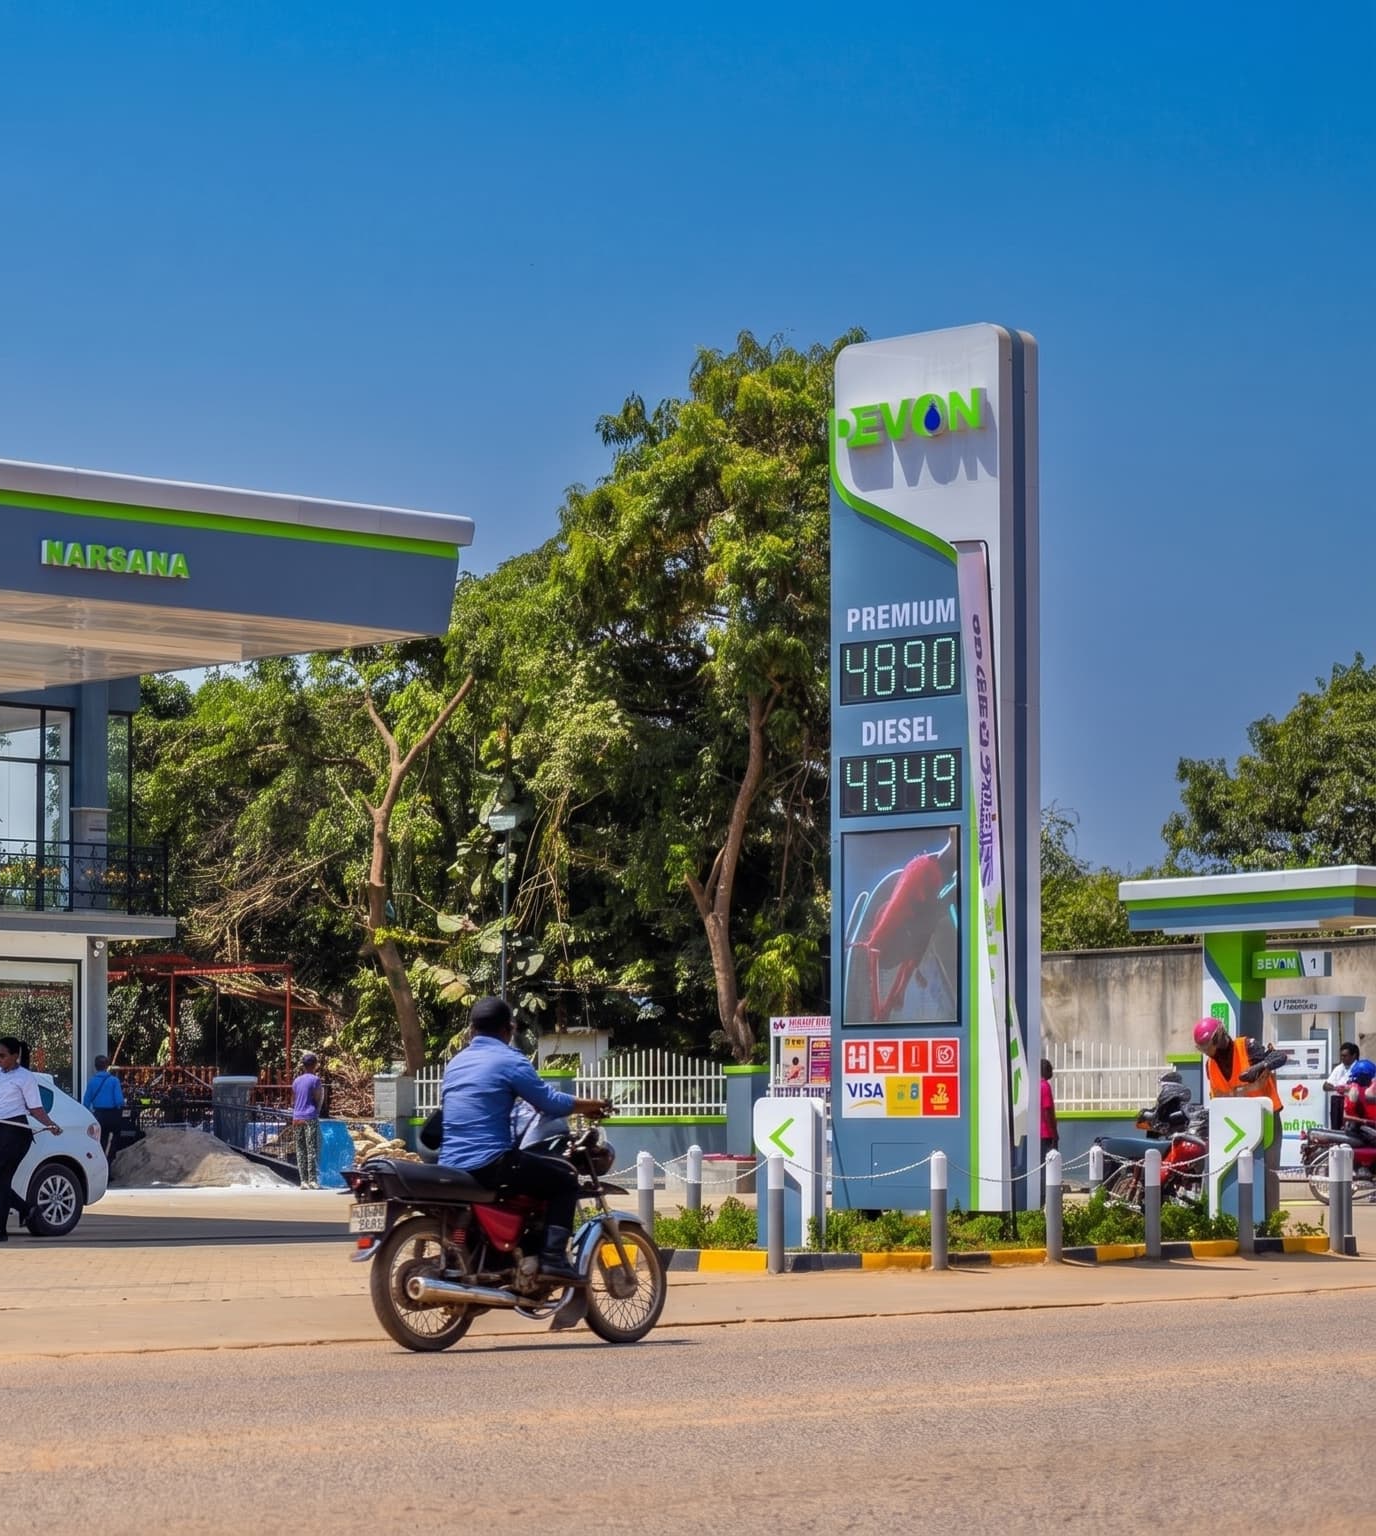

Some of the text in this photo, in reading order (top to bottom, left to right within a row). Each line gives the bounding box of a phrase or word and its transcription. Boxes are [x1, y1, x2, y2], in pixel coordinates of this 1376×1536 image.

[837, 387, 985, 448] DEVON
[41, 539, 190, 578] NARSANA
[847, 598, 955, 632] PREMIUM
[846, 637, 955, 696] 4890
[862, 716, 938, 746] DIESEL
[846, 754, 955, 811] 4349
[1310, 957, 1317, 969] 1
[846, 1082, 884, 1098] VISA
